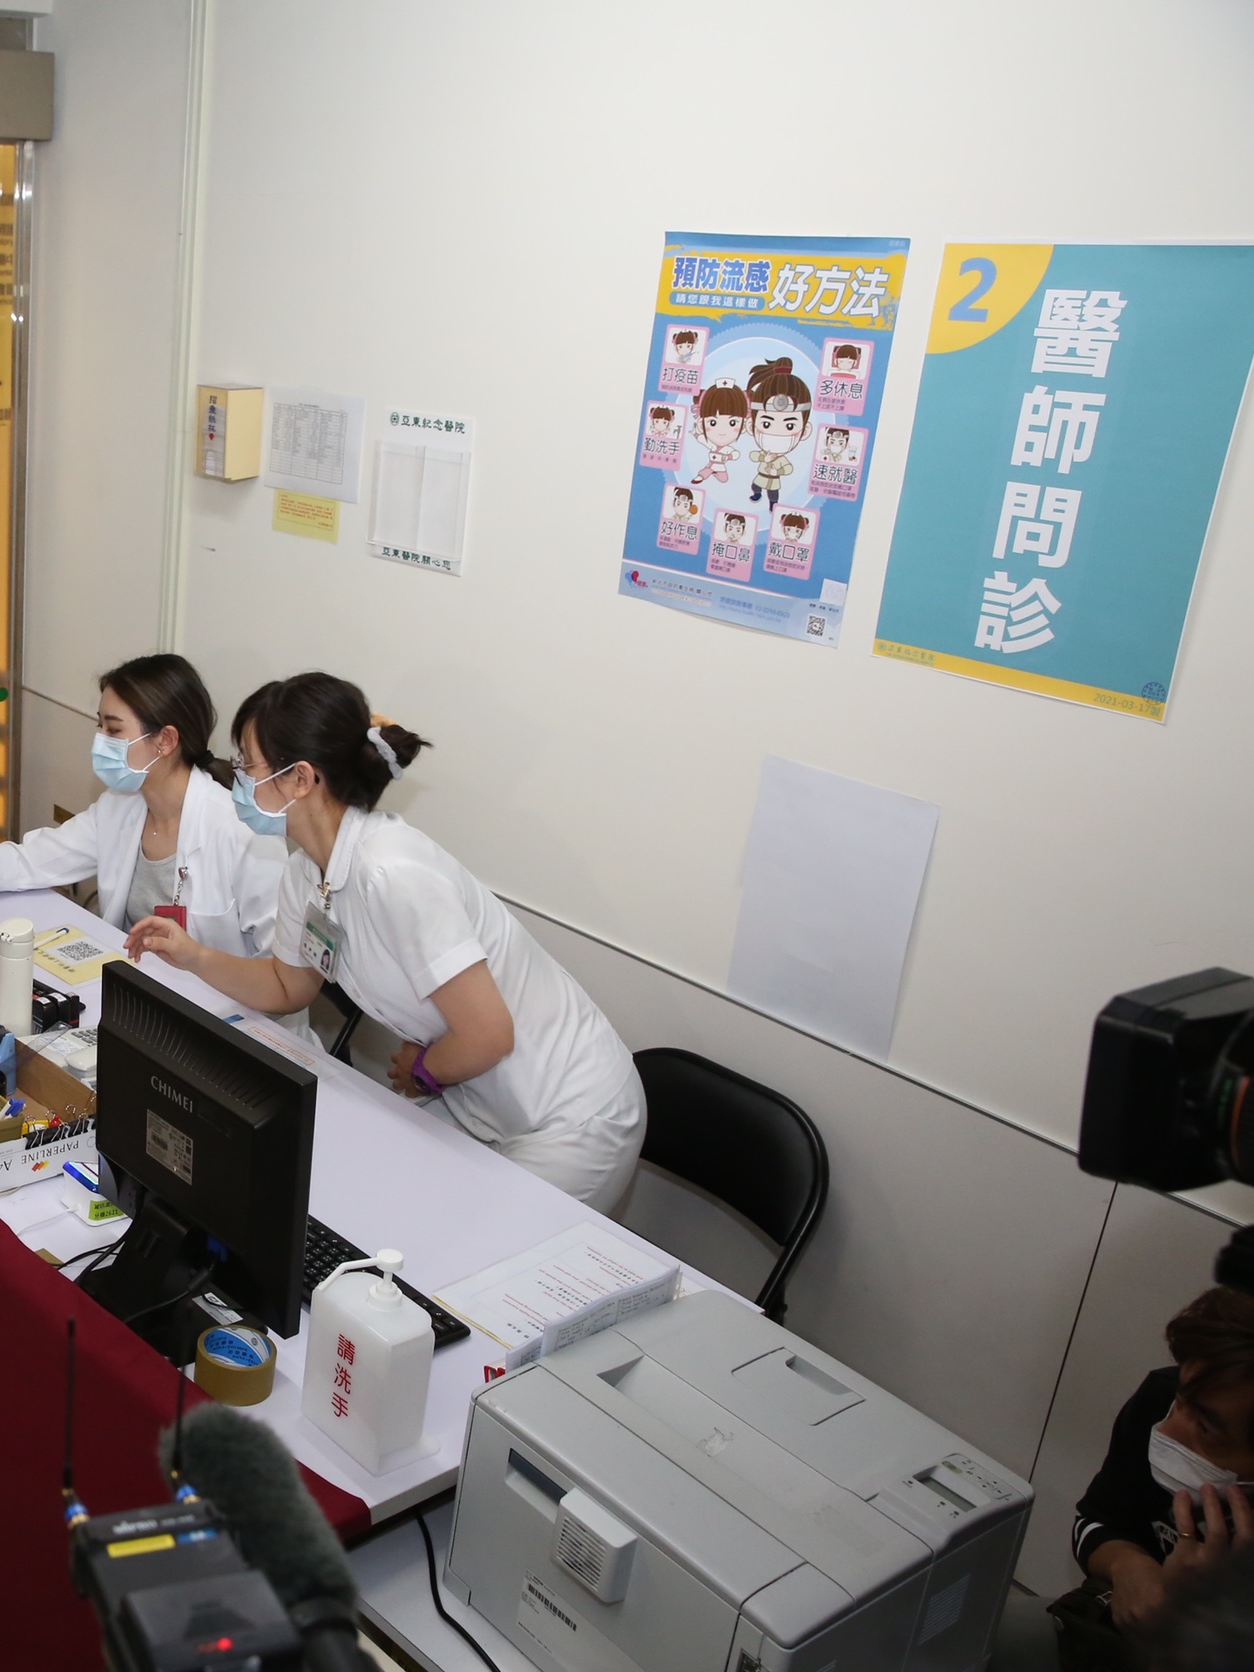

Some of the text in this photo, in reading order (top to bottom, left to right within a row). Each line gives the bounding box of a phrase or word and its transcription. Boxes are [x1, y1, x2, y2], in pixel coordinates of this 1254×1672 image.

[672, 256, 891, 319] 預防流感 好方法
[947, 256, 998, 323] 2
[675, 294, 759, 309] 請您跟我這樣做
[662, 367, 700, 385] 打疫苗
[819, 379, 864, 400] 多休息
[401, 414, 466, 434] 亞東紀念醫院
[643, 437, 680, 456] 勤洗手
[812, 463, 858, 485] 速就醫
[973, 288, 1129, 655] 醫師問診
[660, 520, 698, 541] 好作息
[381, 546, 452, 571] 亞東醫院關心您
[711, 541, 751, 562] 掩口鼻
[767, 541, 810, 562] 戴口罩
[150, 1075, 194, 1115] CHIMEI
[21, 1139, 80, 1165] PAPERLINE
[331, 1333, 356, 1420] 請洗手
